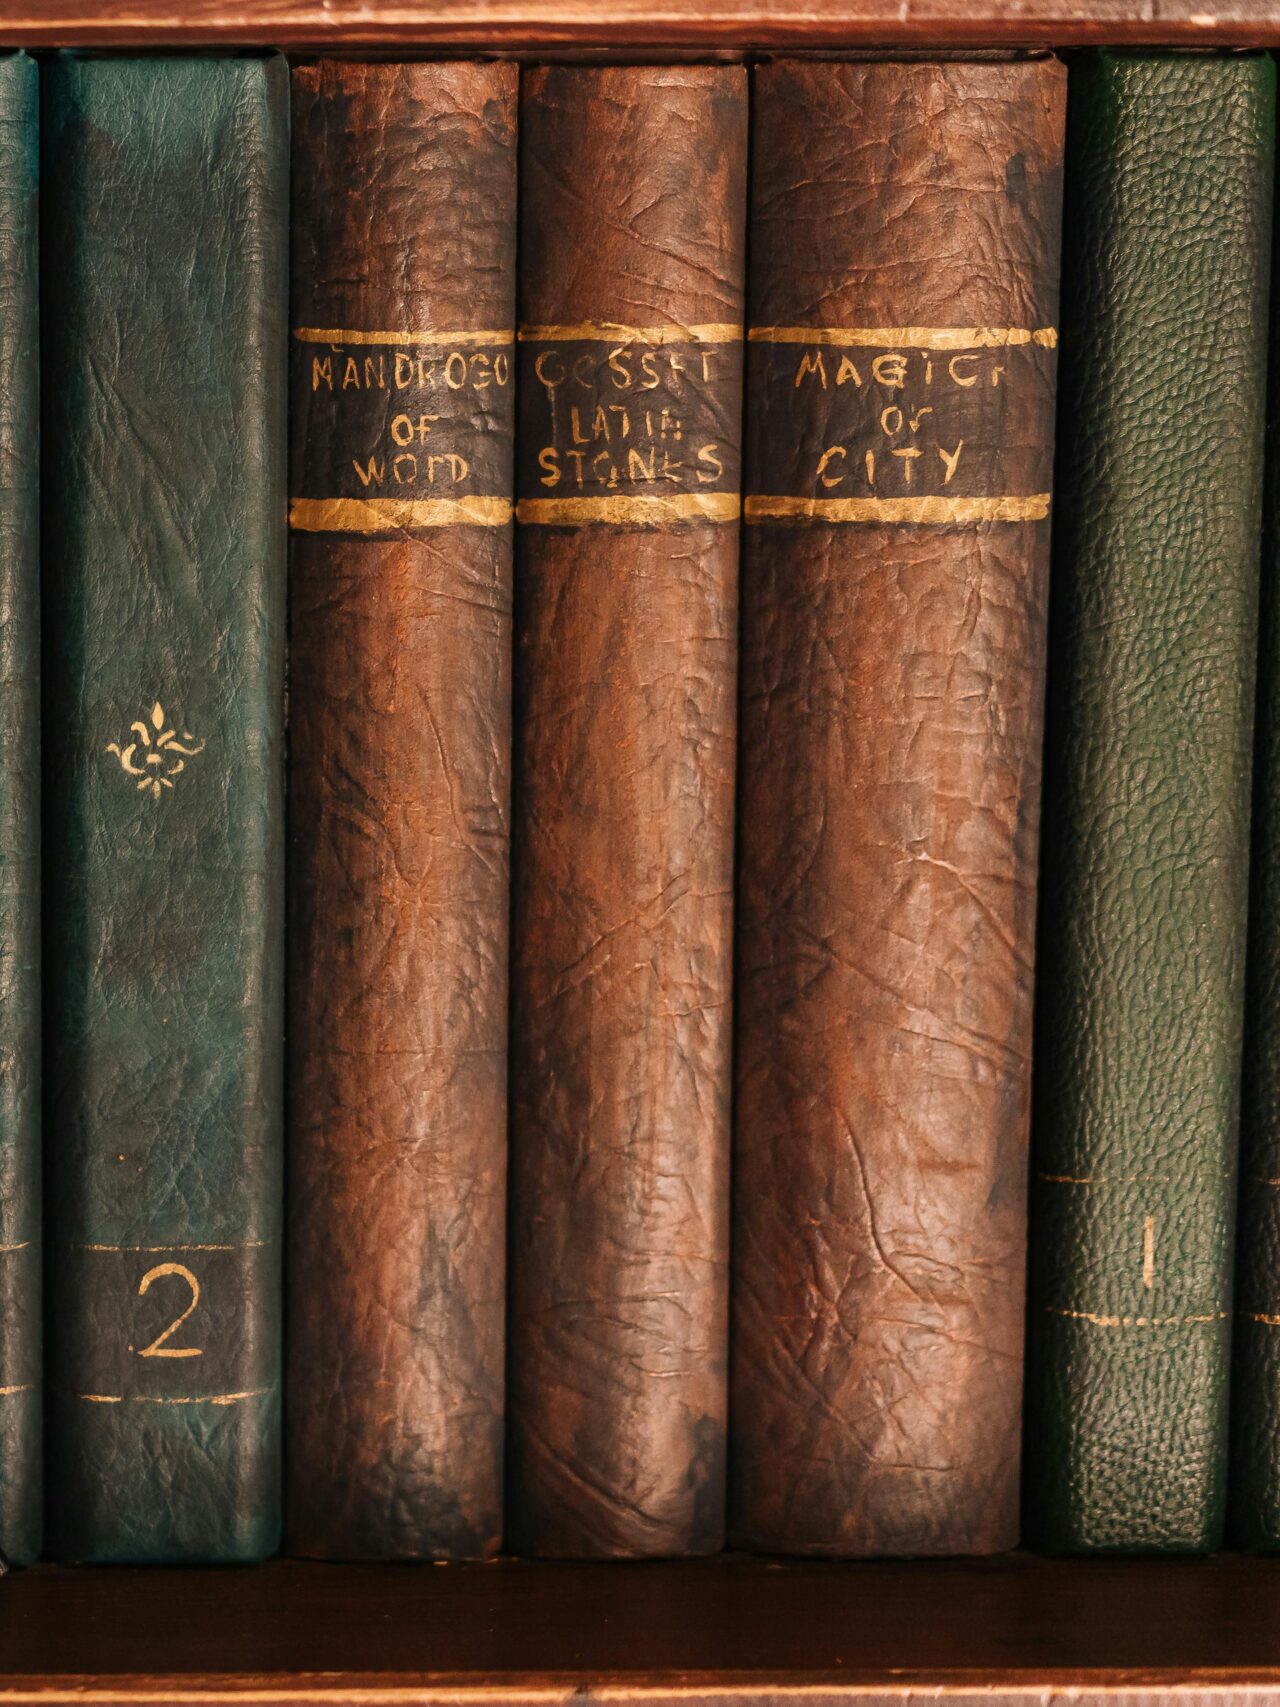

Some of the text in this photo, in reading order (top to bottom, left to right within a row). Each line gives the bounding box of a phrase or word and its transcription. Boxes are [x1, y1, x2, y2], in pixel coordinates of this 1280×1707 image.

[391, 413, 440, 447] OF
[815, 439, 964, 488] CITY
[137, 1262, 204, 1358] 2
